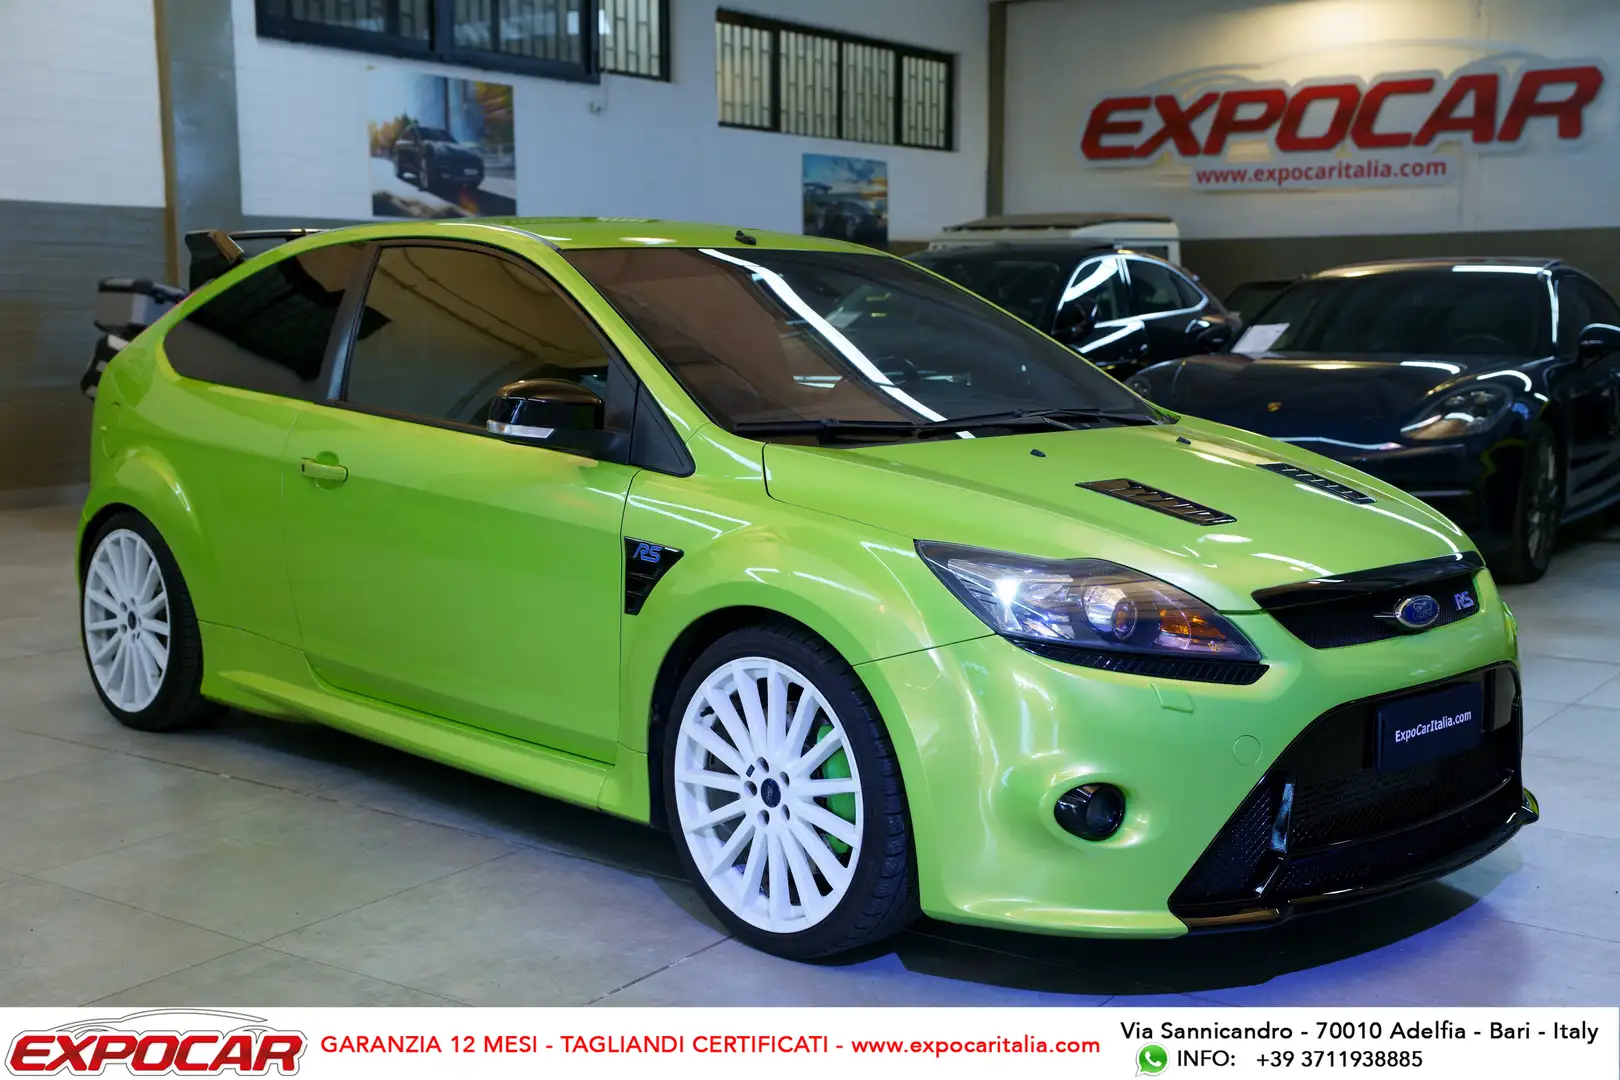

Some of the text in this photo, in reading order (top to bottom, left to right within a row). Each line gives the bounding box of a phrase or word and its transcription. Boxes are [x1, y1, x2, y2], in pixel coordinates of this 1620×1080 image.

[1081, 66, 1603, 159] EXPOCAR
[1196, 160, 1447, 185] www.expocaritalia.com
[633, 543, 662, 563] RS
[1454, 591, 1474, 610] RS
[1395, 711, 1472, 742] ExpoCarItalia.com
